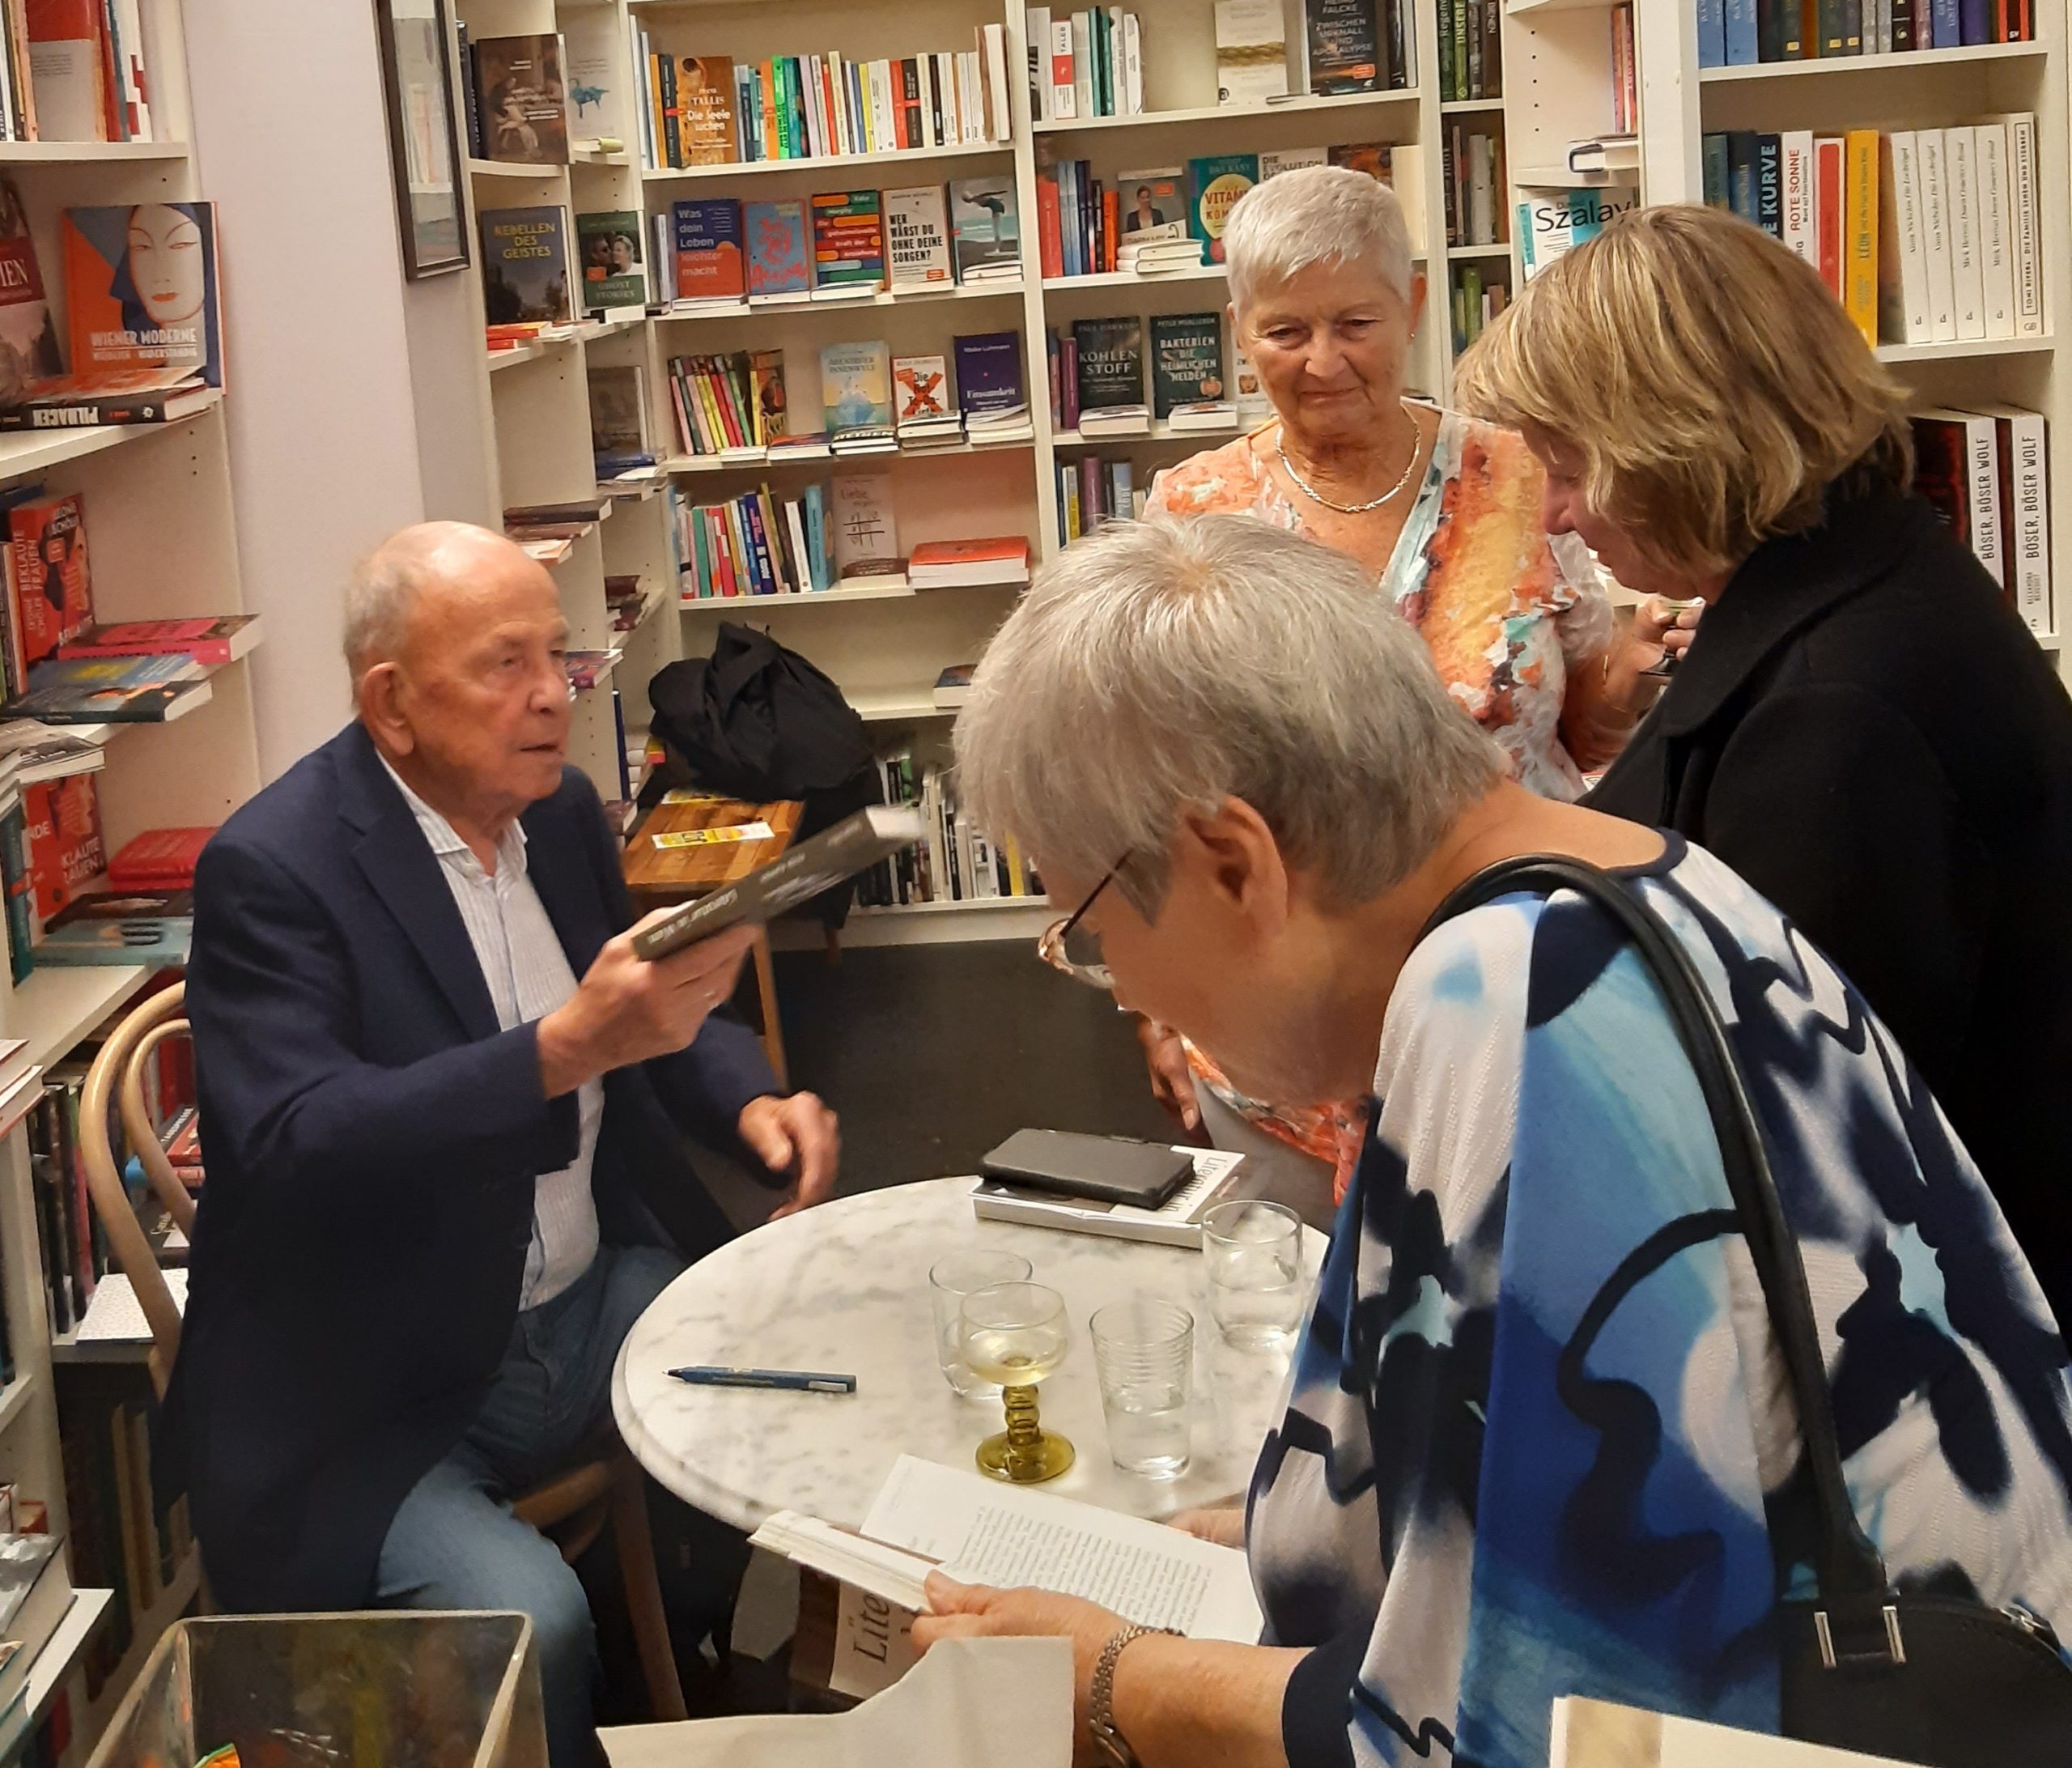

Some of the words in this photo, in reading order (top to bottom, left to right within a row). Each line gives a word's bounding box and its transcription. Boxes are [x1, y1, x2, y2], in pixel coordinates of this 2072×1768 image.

[1789, 149, 1800, 194] SONNE
[1760, 144, 1778, 215] KURVE
[677, 208, 703, 219] Was
[889, 214, 907, 225] WER
[1790, 197, 1801, 232] ROTE
[493, 223, 555, 236] REBELLEN
[679, 223, 703, 234] dein
[890, 225, 919, 238] WÄRST
[922, 224, 934, 235] DU
[514, 236, 537, 247] DES
[680, 238, 715, 249] Leben
[891, 239, 915, 251] OHNE
[916, 236, 944, 248] DEINE
[503, 246, 552, 259] GEISTES
[893, 249, 932, 263] SORGEN?
[681, 266, 718, 277] macht
[91, 330, 138, 347] WIENER
[139, 327, 197, 345] MODERNE
[1159, 336, 1216, 349] BAKTERIEN
[1078, 349, 1138, 363] KOHLEN
[1086, 363, 1132, 376] STOFF
[1976, 438, 1989, 470] WOLF
[2022, 436, 2037, 469] WOLF
[1978, 474, 1993, 513] BÖSER
[2021, 473, 2039, 512] BÖSER
[1978, 516, 1995, 560] BÖSER,
[2023, 515, 2040, 559] BÖSER,
[13, 529, 31, 592] BEKLAUTE
[28, 538, 45, 590] FRAUEN
[1176, 1156, 1228, 1201] Literatur
